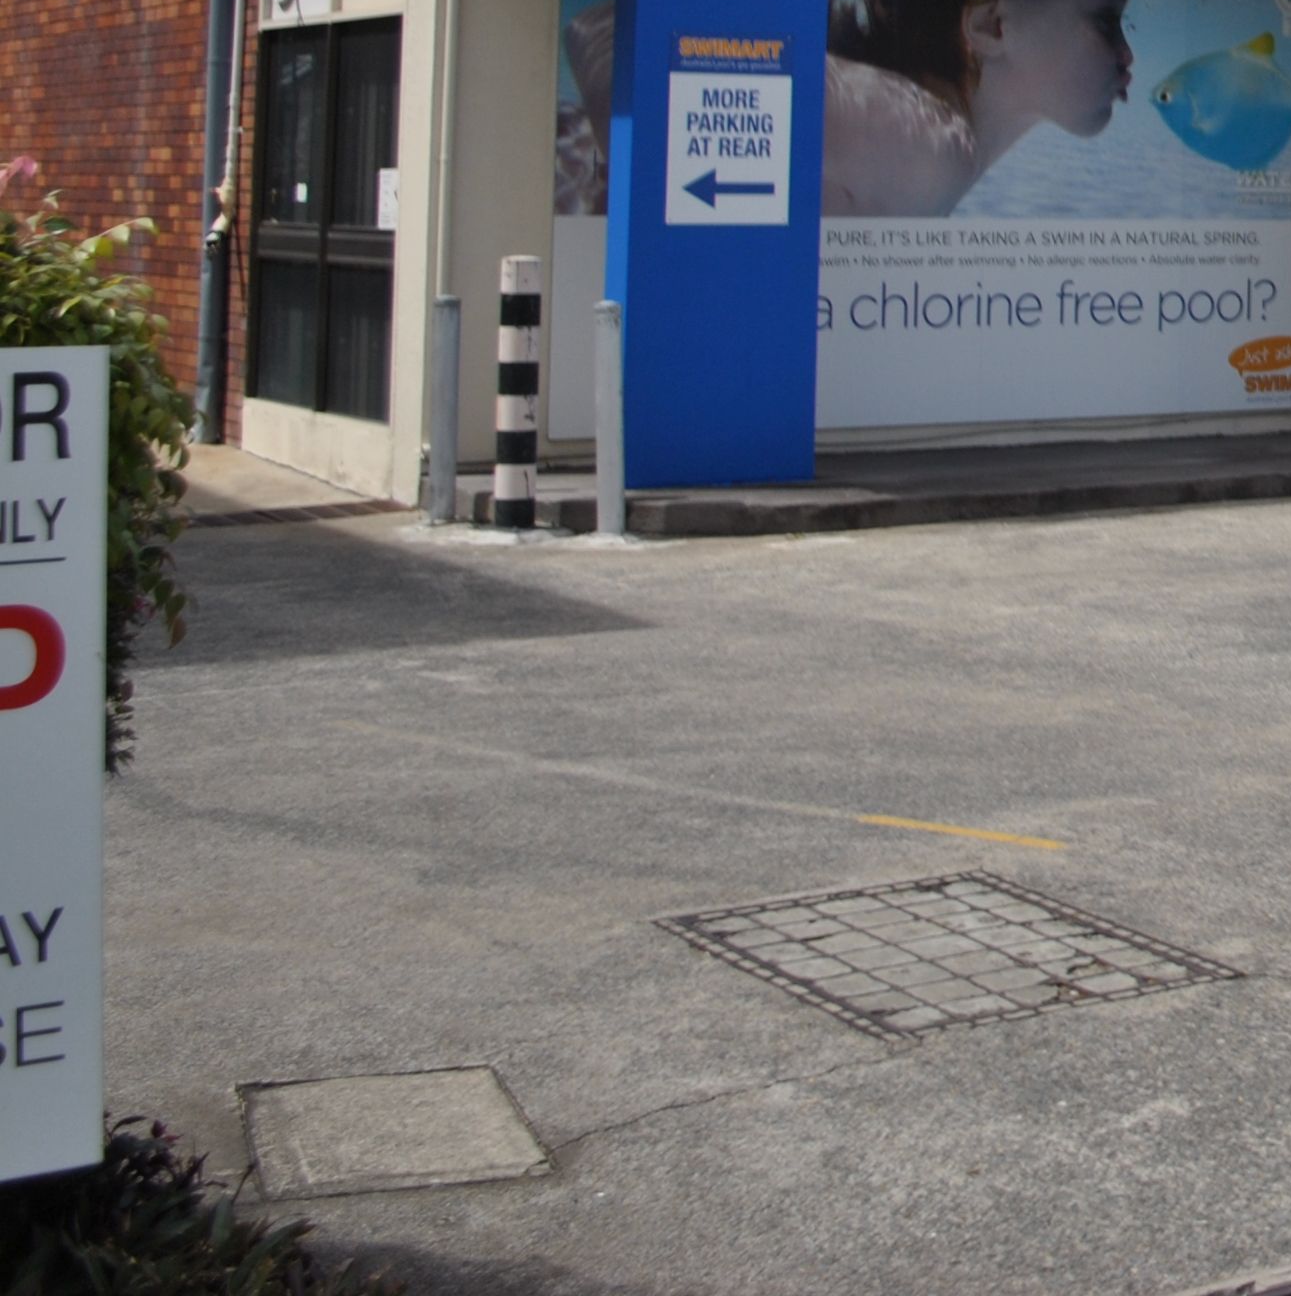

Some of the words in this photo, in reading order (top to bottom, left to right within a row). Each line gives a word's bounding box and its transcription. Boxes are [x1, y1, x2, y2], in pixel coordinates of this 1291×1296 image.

[679, 35, 785, 62] SWIMART
[702, 88, 760, 110] MORE
[686, 111, 774, 134] PARKING
[687, 136, 713, 157] AT
[718, 137, 772, 159] REAR
[826, 229, 878, 248] PURE,
[881, 229, 912, 247] IT'S
[915, 229, 950, 247] LIKE
[957, 229, 1021, 247] TAKING
[1025, 230, 1037, 246] A
[1041, 230, 1085, 246] SWIM
[1089, 230, 1105, 246] IN
[1110, 230, 1122, 246] A
[1126, 230, 1199, 246] NATURAL
[1203, 230, 1260, 246] SPRING.
[861, 255, 880, 267] No
[883, 255, 924, 267] shower
[928, 254, 954, 266] after
[957, 255, 1016, 269] swimming
[1027, 254, 1044, 266] No
[1046, 254, 1085, 268] allergic
[1088, 254, 1138, 266] reactions
[1149, 254, 1196, 266] Absolute
[1198, 254, 1227, 266] water
[817, 294, 834, 331] a
[850, 281, 1043, 331] chlorine
[1055, 279, 1144, 326] free
[1157, 278, 1278, 332] pool?
[0, 497, 67, 545] LY
